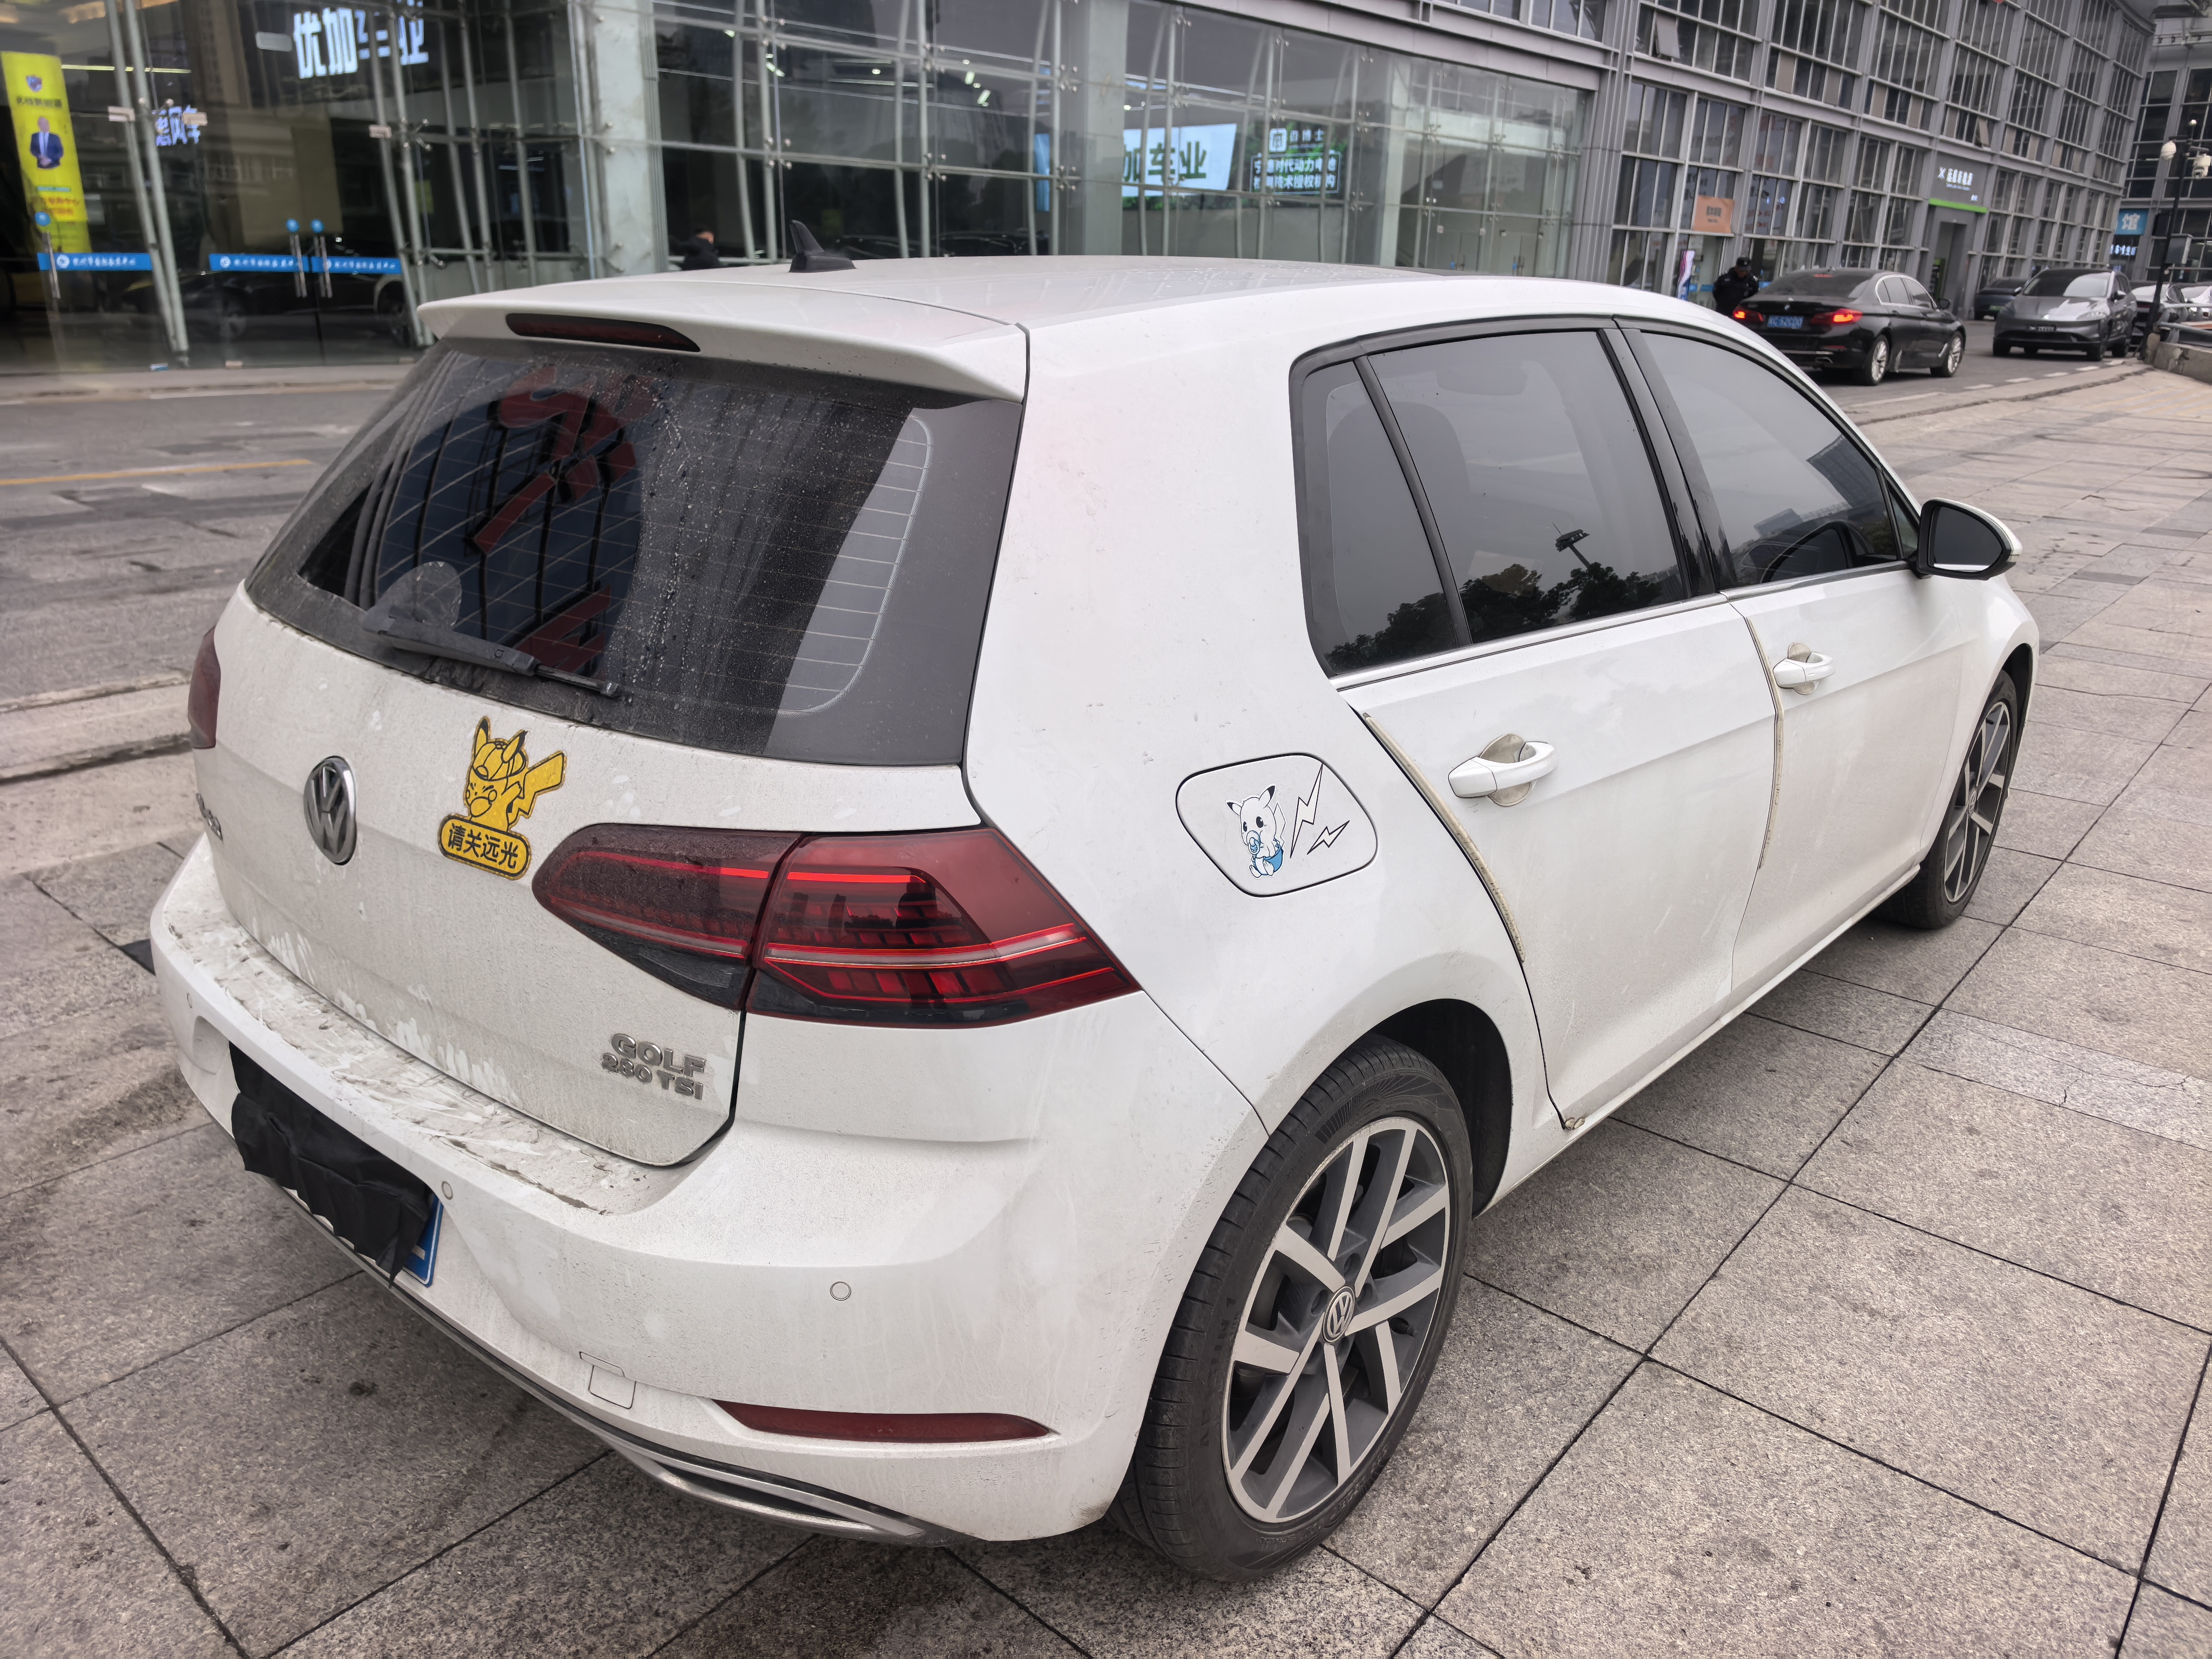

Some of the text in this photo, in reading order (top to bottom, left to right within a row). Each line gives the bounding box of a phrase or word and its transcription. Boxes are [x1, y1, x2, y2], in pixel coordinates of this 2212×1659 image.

[448, 822, 519, 869] 请关远光
[601, 1052, 704, 1101] 280 TSI
[611, 1033, 707, 1077] GOLF
